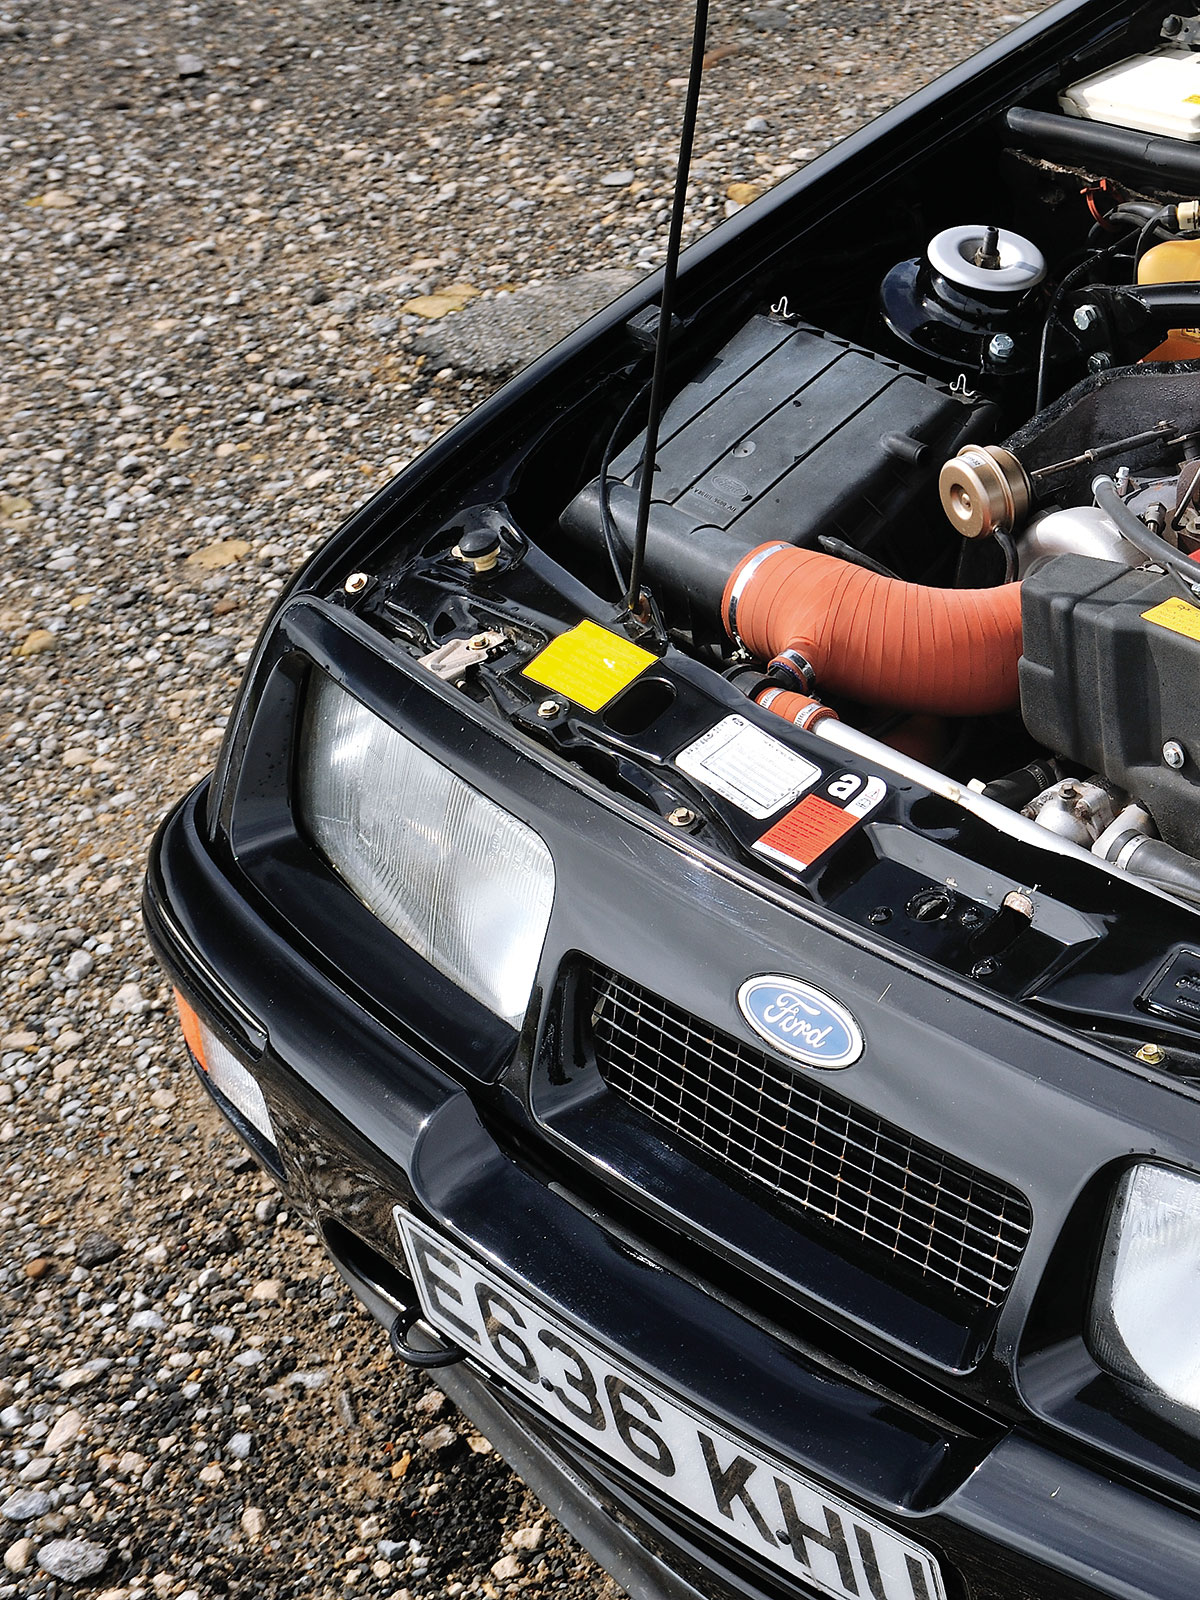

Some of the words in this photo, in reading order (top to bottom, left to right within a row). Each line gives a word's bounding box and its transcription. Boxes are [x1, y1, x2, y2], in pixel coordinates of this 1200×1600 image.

[826, 773, 862, 801] a
[763, 992, 833, 1048] Ford
[419, 1240, 678, 1478] E636
